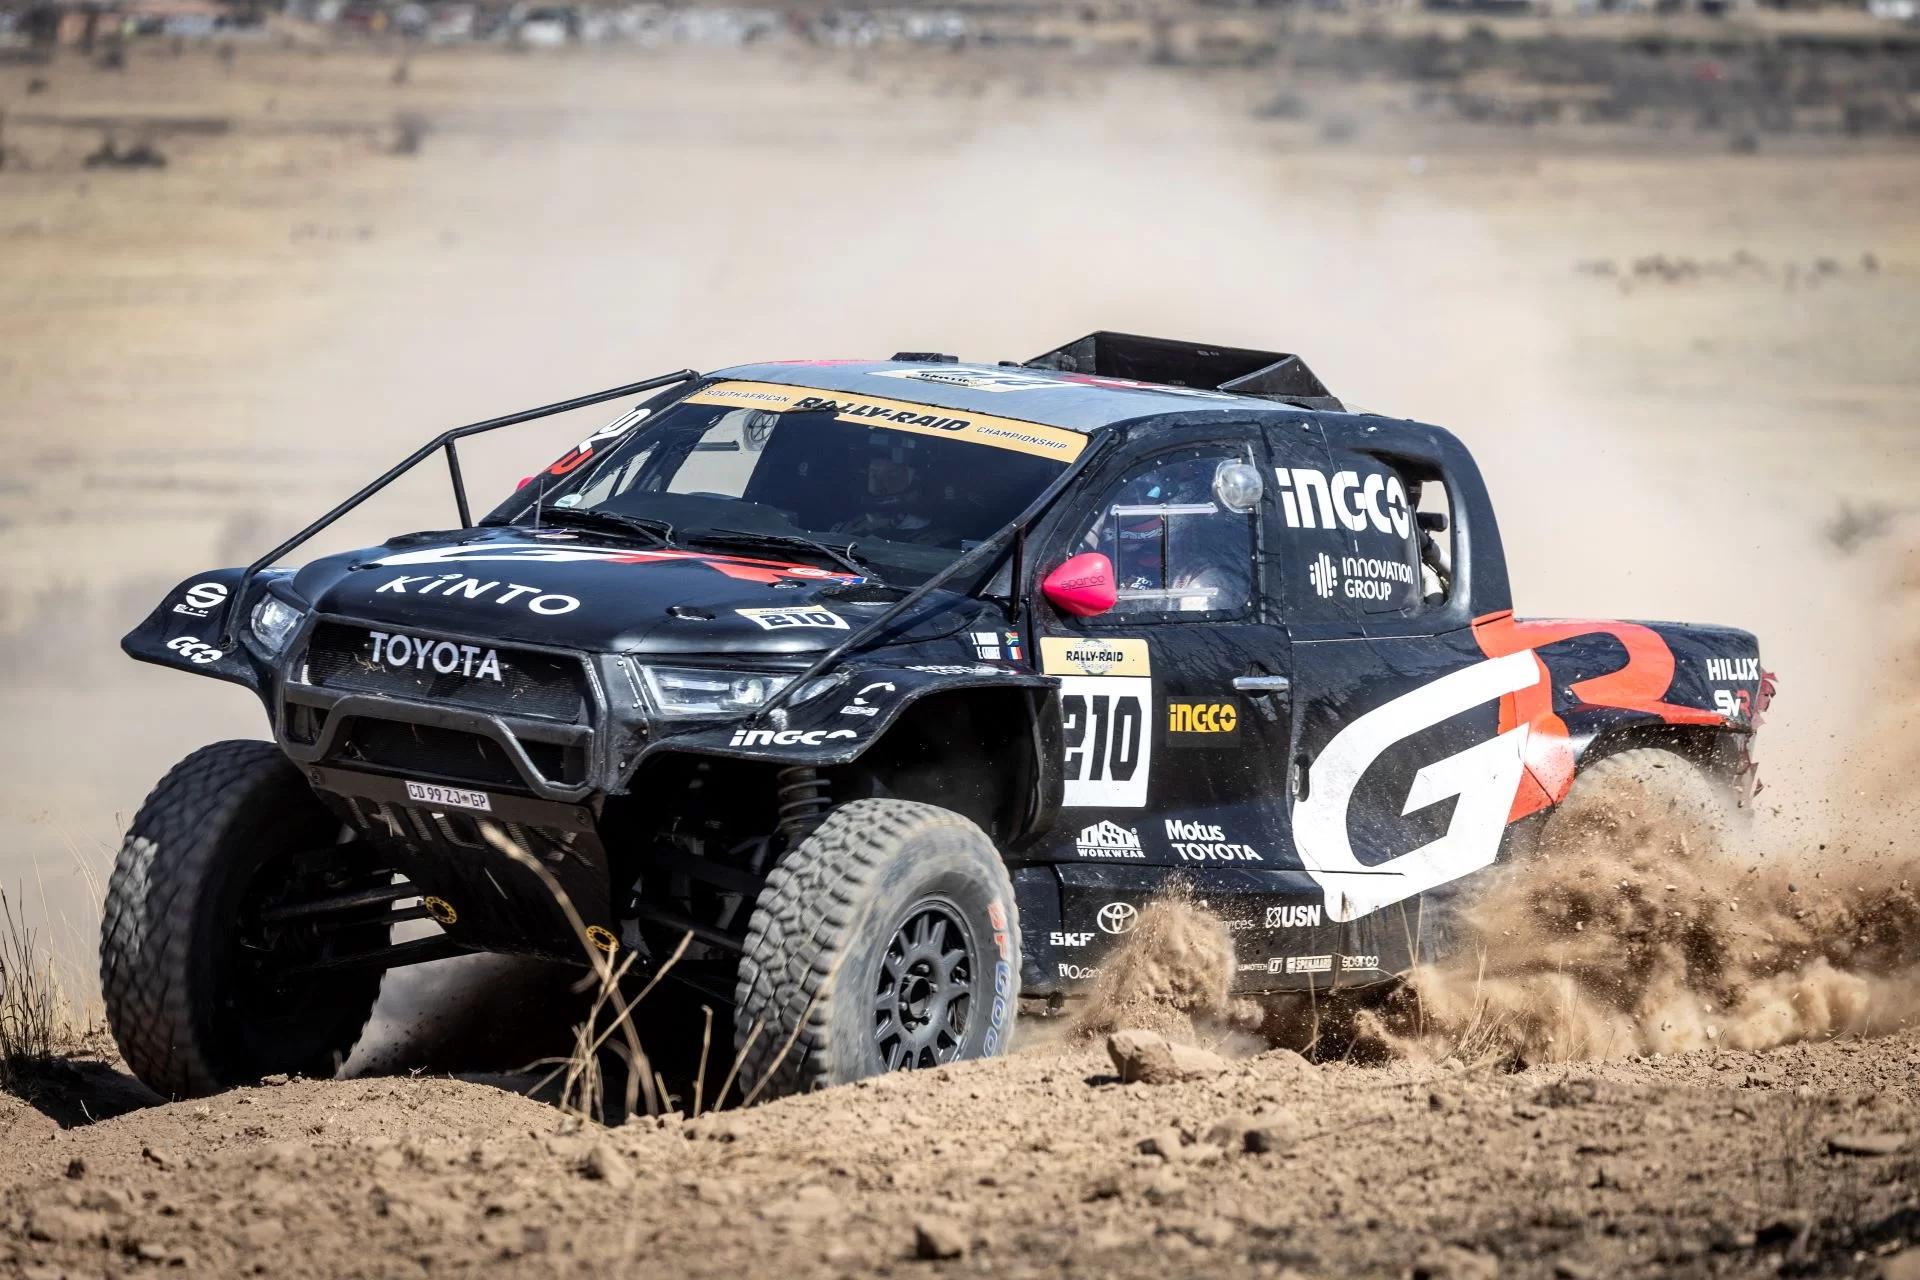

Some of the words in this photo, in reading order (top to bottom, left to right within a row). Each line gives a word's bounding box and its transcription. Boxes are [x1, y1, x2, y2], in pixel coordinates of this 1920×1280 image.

[704, 388, 743, 400] SOUTH
[742, 391, 791, 403] AFRICAN
[792, 396, 972, 432] RALLY-RAID
[976, 425, 1068, 450] CHAMPIONSHIP
[1341, 556, 1414, 585] INNOVATION
[1060, 574, 1106, 593] sparco
[1343, 578, 1393, 601] GROUP
[759, 612, 837, 627] 210
[369, 631, 503, 681] TOYOTA
[1065, 650, 1124, 662] RALLY-RAID
[1705, 657, 1760, 681] HILUX
[1062, 694, 1143, 782] 210
[408, 784, 426, 799] CD
[427, 787, 441, 801] 99
[443, 789, 462, 804] ZJ
[470, 793, 486, 807] GP
[1075, 819, 1141, 847] JONSSON
[1164, 819, 1226, 842] Motus
[1076, 848, 1147, 859] WORKWEAR
[1171, 842, 1264, 862] TOYOTA
[1282, 904, 1321, 928] USN
[1049, 931, 1096, 947] SKF
[1341, 955, 1379, 972] sparco
